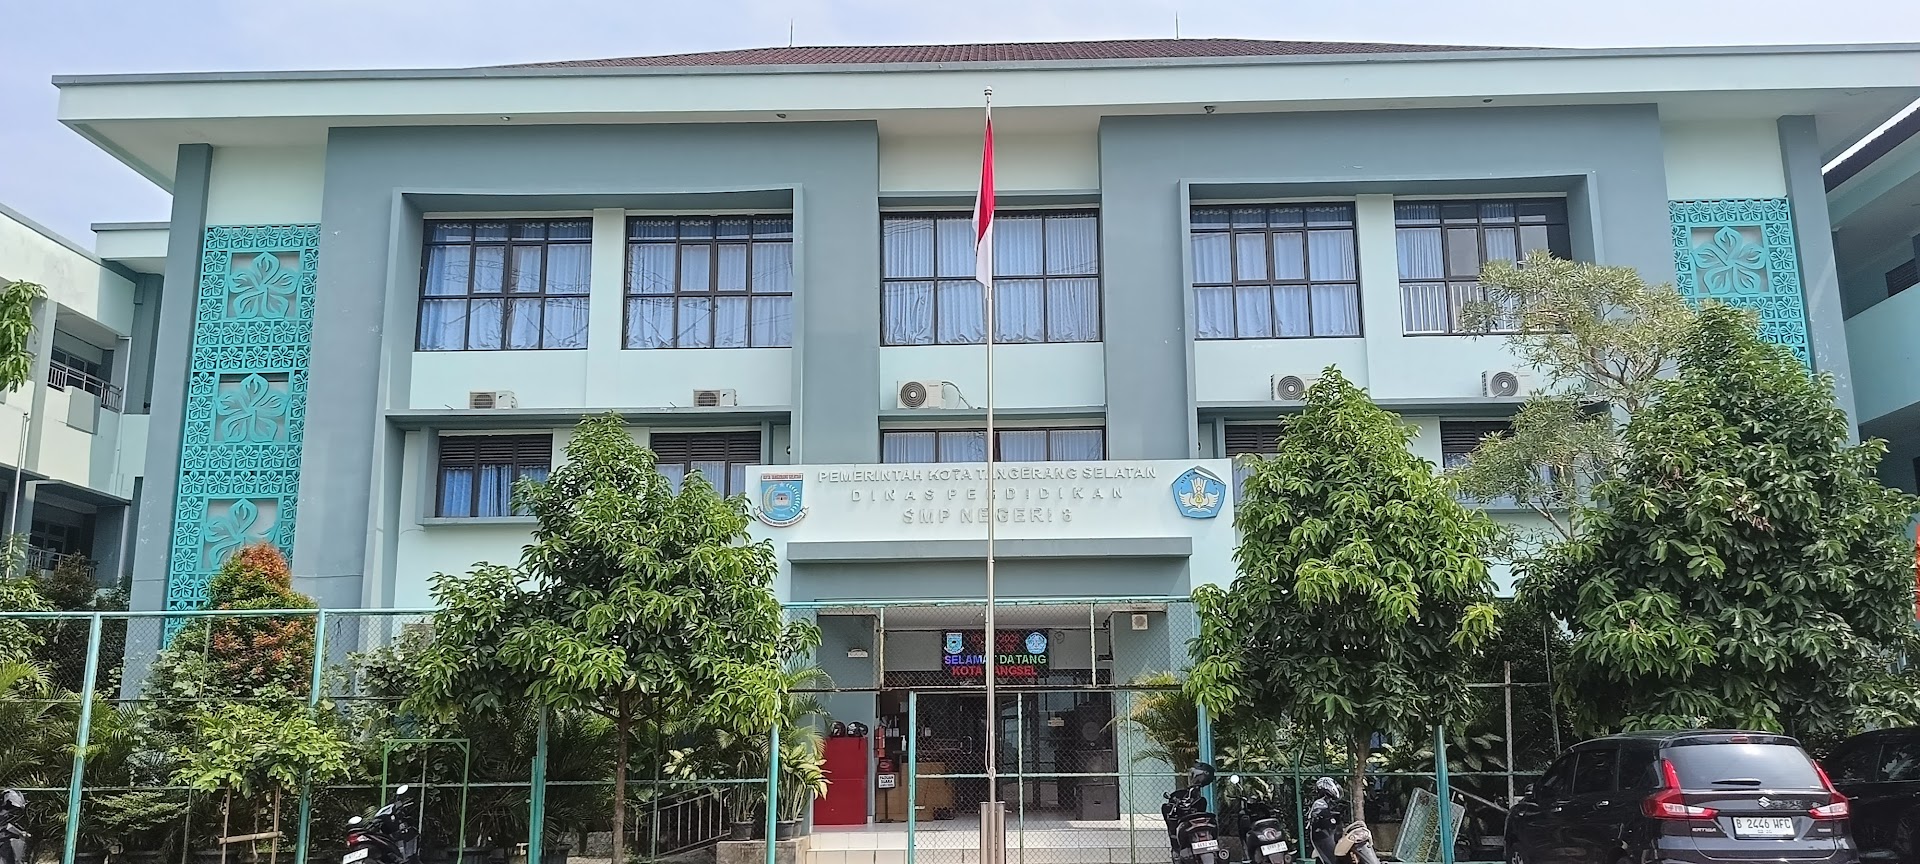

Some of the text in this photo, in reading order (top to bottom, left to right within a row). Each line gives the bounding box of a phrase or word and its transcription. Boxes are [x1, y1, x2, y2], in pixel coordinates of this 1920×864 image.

[818, 469, 923, 483] PEMERINTAH
[928, 468, 972, 481] KOTA
[1082, 466, 1157, 479] SELATAN
[851, 489, 934, 501] DINAS
[903, 508, 1073, 524] SMP NEGERI 8
[944, 654, 1047, 665] SELAMA DATANG
[952, 665, 1038, 676] KOTA ANGSEL
[1736, 818, 1743, 829] B
[1747, 818, 1770, 829] 2446
